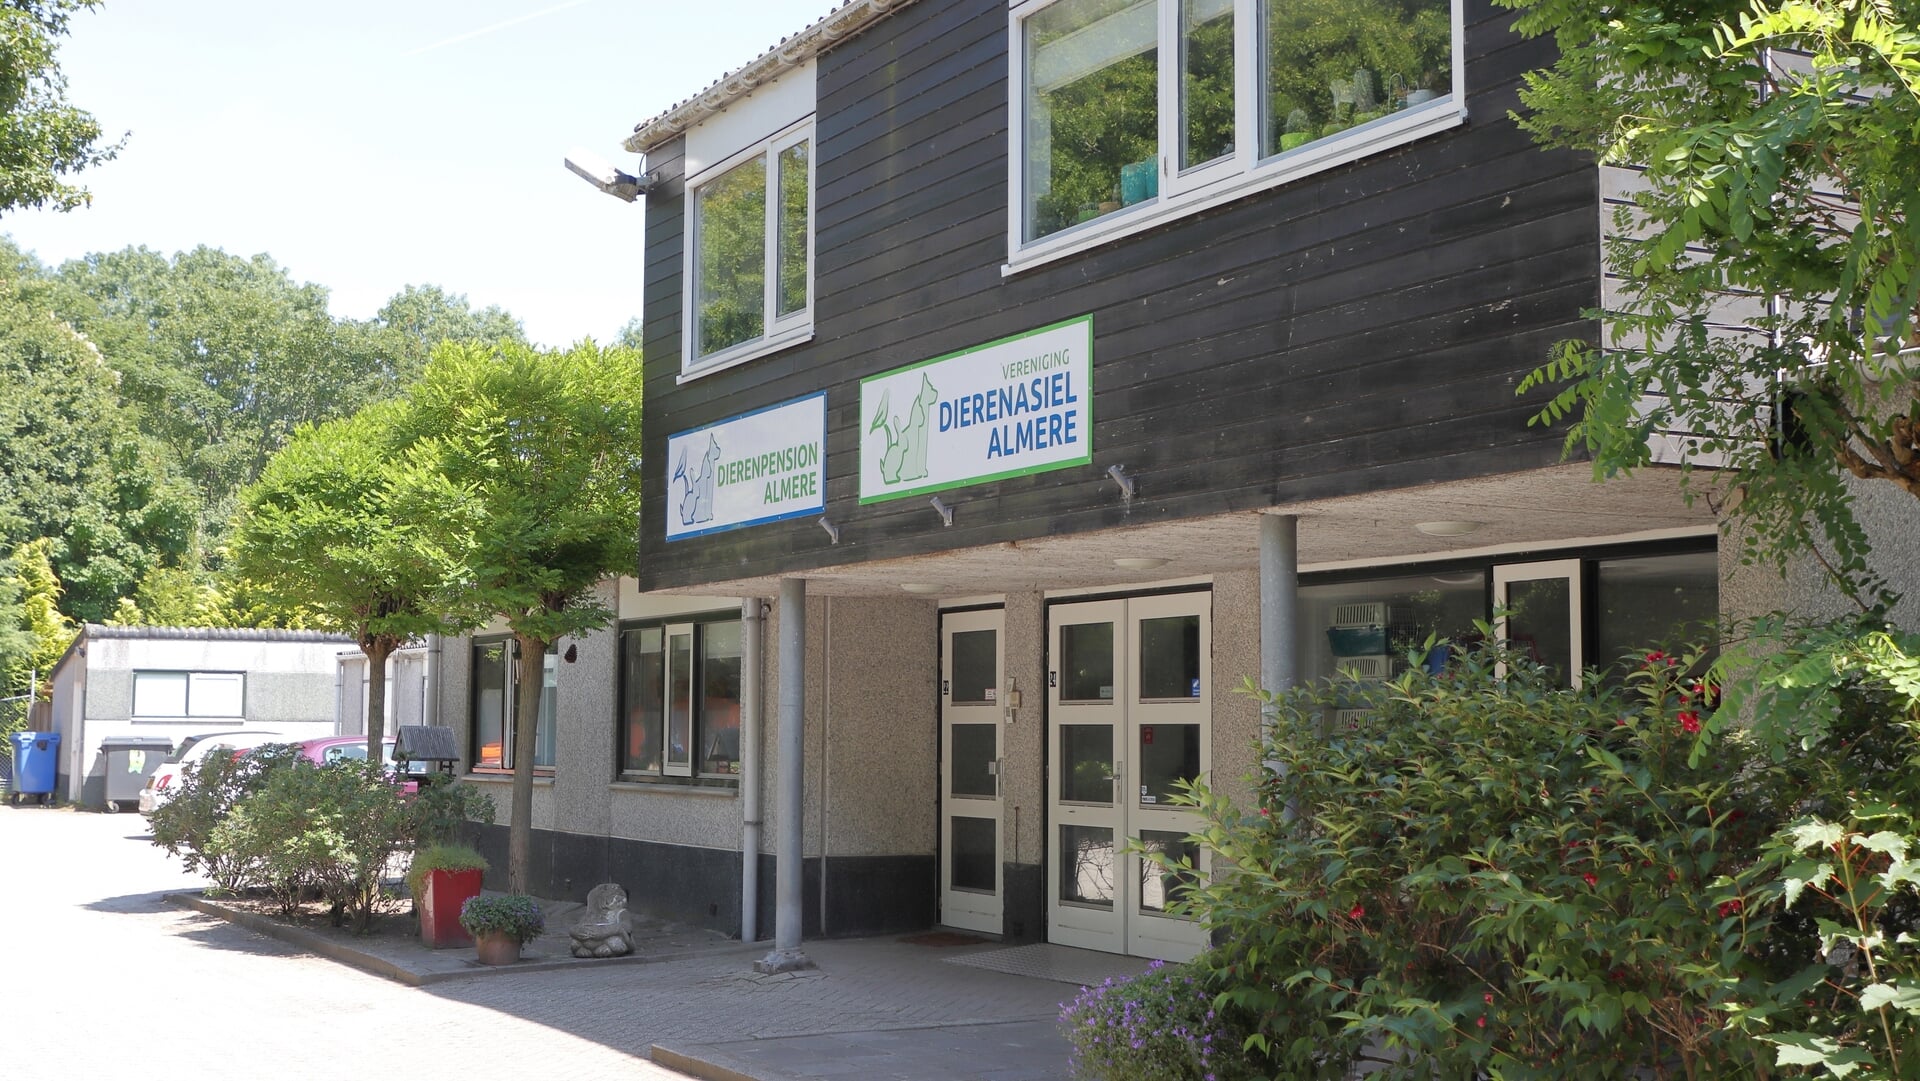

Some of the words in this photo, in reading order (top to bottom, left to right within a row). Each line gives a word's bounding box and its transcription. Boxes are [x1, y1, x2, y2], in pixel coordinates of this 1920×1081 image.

[1002, 348, 1070, 380] VERENIGING
[939, 371, 1077, 433] DIERENASIEL
[987, 409, 1077, 460] ALMERE
[717, 441, 818, 488] DIERENPENSION
[763, 471, 817, 505] ALMERE
